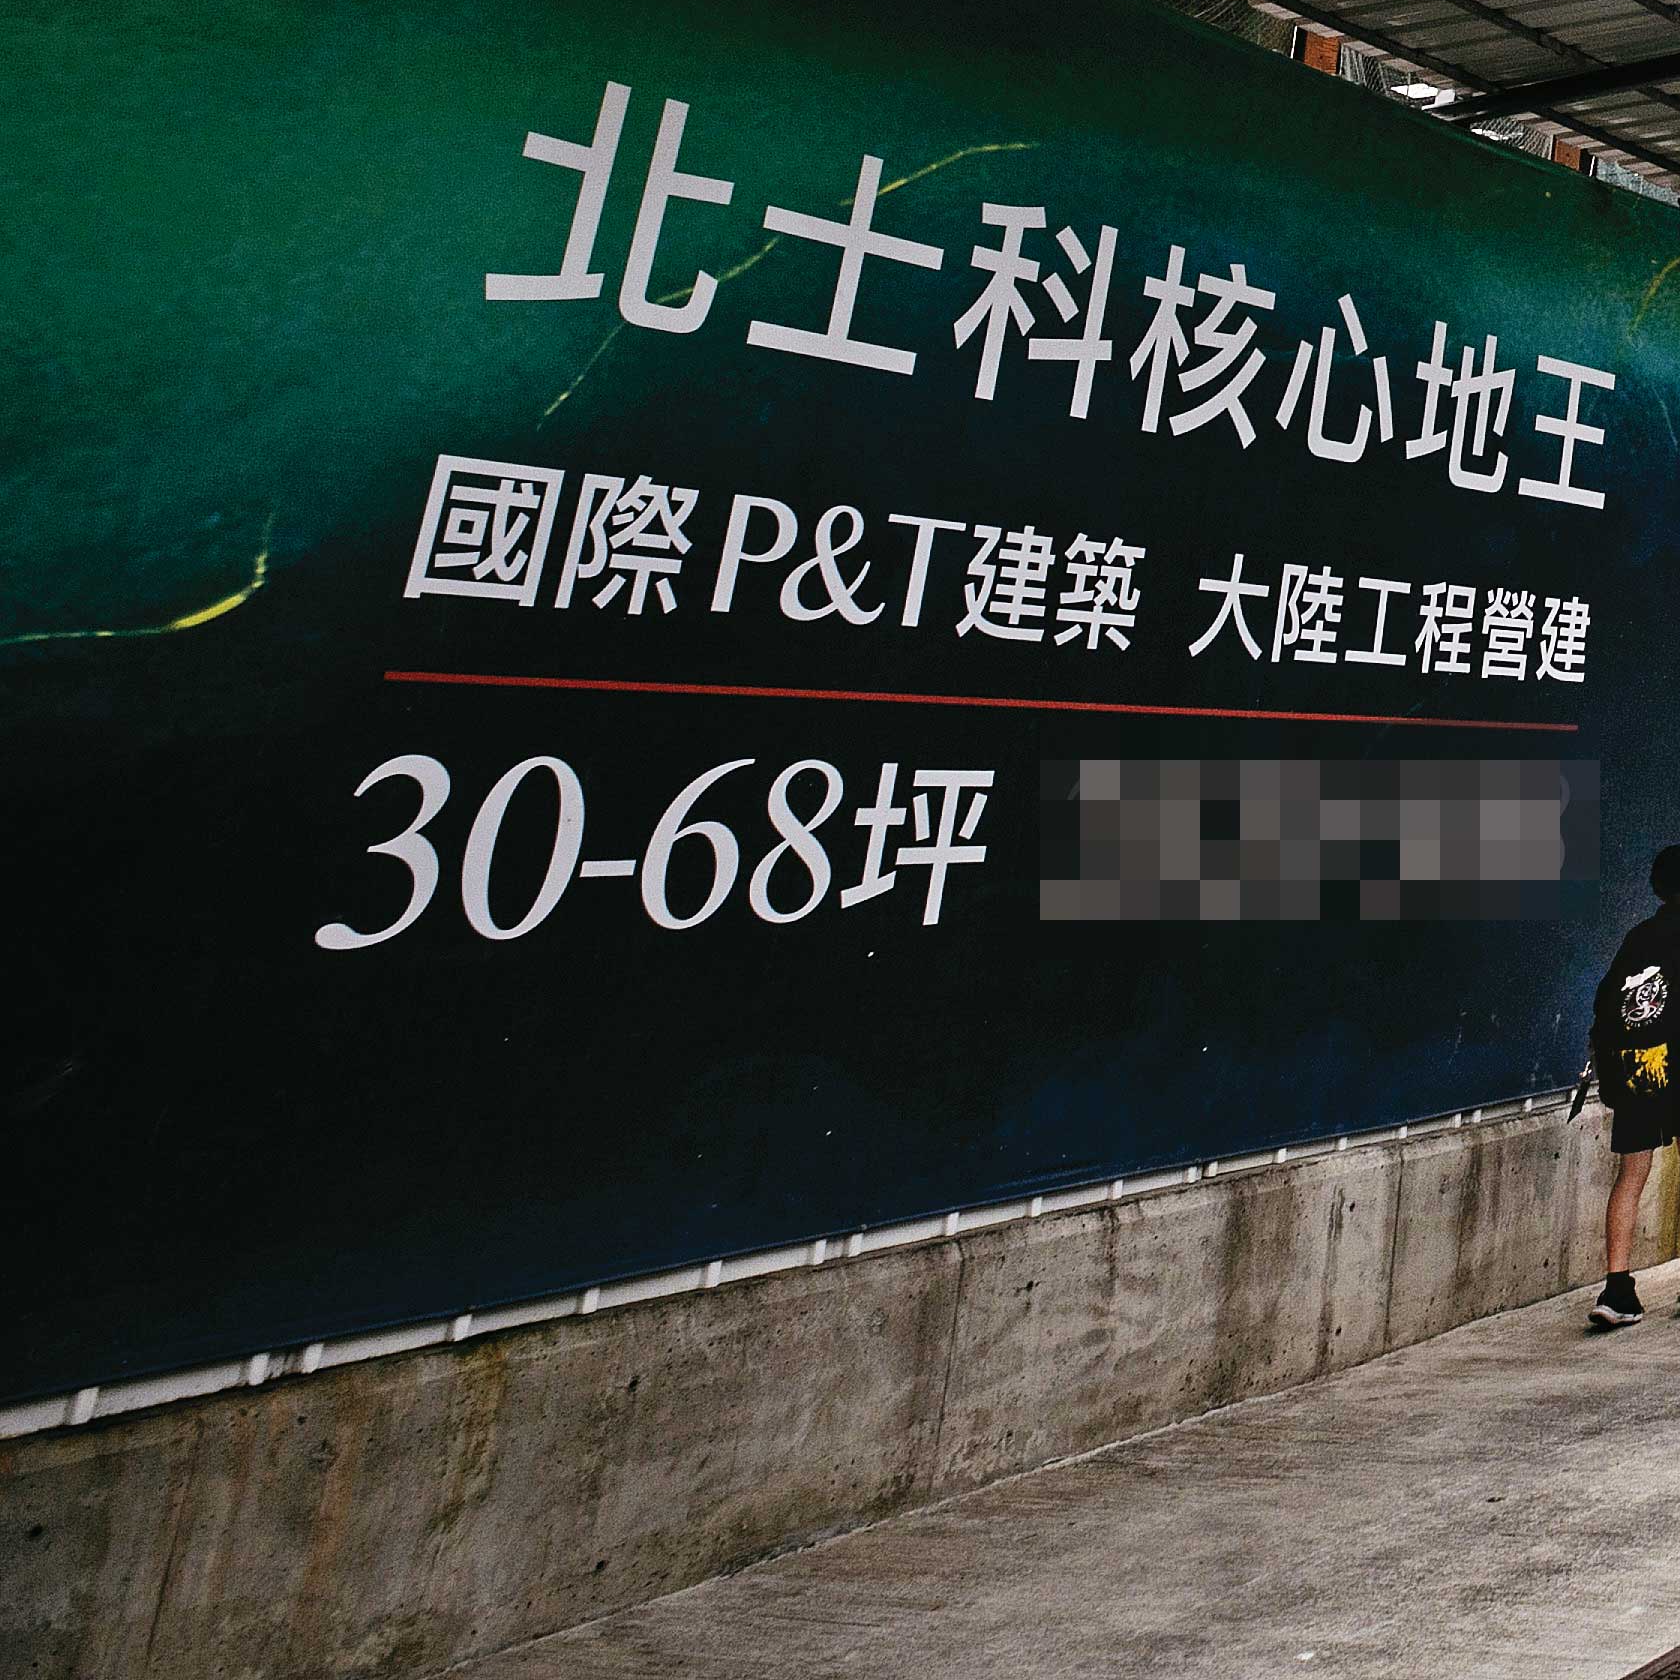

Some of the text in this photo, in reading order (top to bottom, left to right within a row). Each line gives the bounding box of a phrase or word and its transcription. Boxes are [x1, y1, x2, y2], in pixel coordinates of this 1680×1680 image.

[485, 81, 1615, 509] 北士科核心地王
[402, 453, 1592, 684] 國際P&T建築 大陸工程營建
[313, 754, 996, 950] 30-68坪
